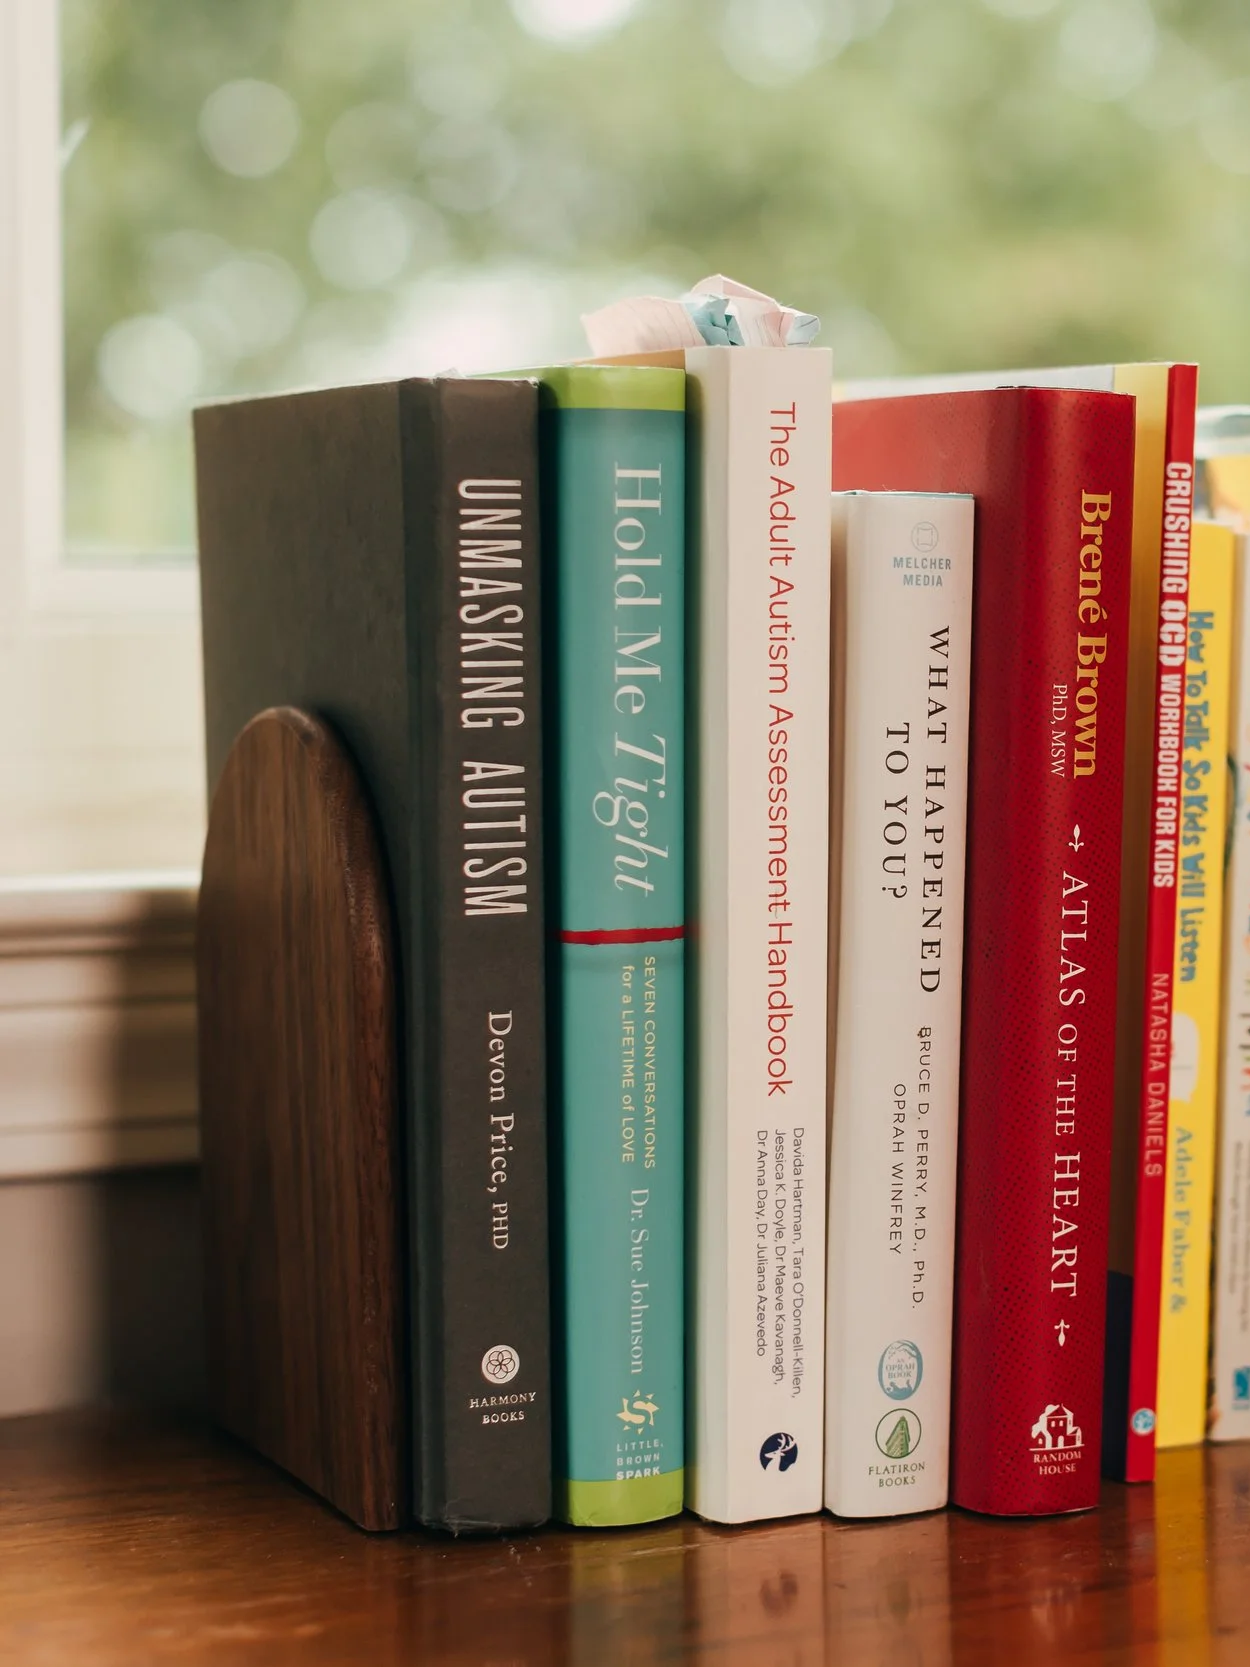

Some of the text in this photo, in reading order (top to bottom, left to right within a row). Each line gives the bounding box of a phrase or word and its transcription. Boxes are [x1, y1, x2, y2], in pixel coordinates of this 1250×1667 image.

[893, 556, 952, 570] MELCHER
[903, 574, 943, 587] MEDIA
[1073, 488, 1112, 780] Brené Brown
[457, 478, 528, 916] UNMASKING AUTISM
[592, 461, 669, 898] Hold Me Tight
[768, 401, 796, 1097] The Adult Autism Assessment Handbook
[1050, 683, 1069, 778] PhD, MSW
[1153, 462, 1193, 888] CRUSHING OCD WORKBOOK FOR KIDS
[881, 722, 910, 899] TO YOU?
[920, 625, 950, 993] WHAT HAPPENED
[1179, 611, 1214, 983] How To Talk So Kids Will Listen
[487, 1009, 515, 1250] Devon Price, PHD
[621, 964, 635, 1163] for a LIFETIME of LOVE
[643, 956, 657, 1169] SEVEN CONVERSATIONS
[1050, 870, 1089, 1297] ATLAS OF THE HEART
[1143, 973, 1169, 1177] NATASHA DANIELS
[791, 1178, 805, 1245] Hartman,
[792, 1127, 805, 1176] Davida
[889, 1083, 907, 1255] OPRAH WINFREY
[912, 1026, 932, 1309] BRUCE D. PERRY, M.D., Ph.D.
[1168, 1126, 1194, 1314] Adele Faber &
[630, 1188, 650, 1374] Dr. Sue Johnson
[755, 1130, 769, 1357] Dr Anna Day, Dr Juliana Azevedo
[773, 1128, 787, 1385] Jessica K. Doyle, Dr Maeve Kavanagh,
[792, 1247, 805, 1280] Tara
[469, 1391, 537, 1408] HARMONY
[482, 1410, 525, 1424] BOOKS
[616, 1438, 664, 1452] LITTLE,
[886, 1362, 915, 1372] OPRAH
[888, 1370, 912, 1379] BOOK
[616, 1452, 660, 1466] BROWN
[616, 1466, 661, 1481] SPARK
[868, 1461, 926, 1475] FLATIRON
[879, 1475, 916, 1488] BOOKS
[1033, 1450, 1082, 1463] RANDOM
[1039, 1463, 1077, 1475] HOUSE
